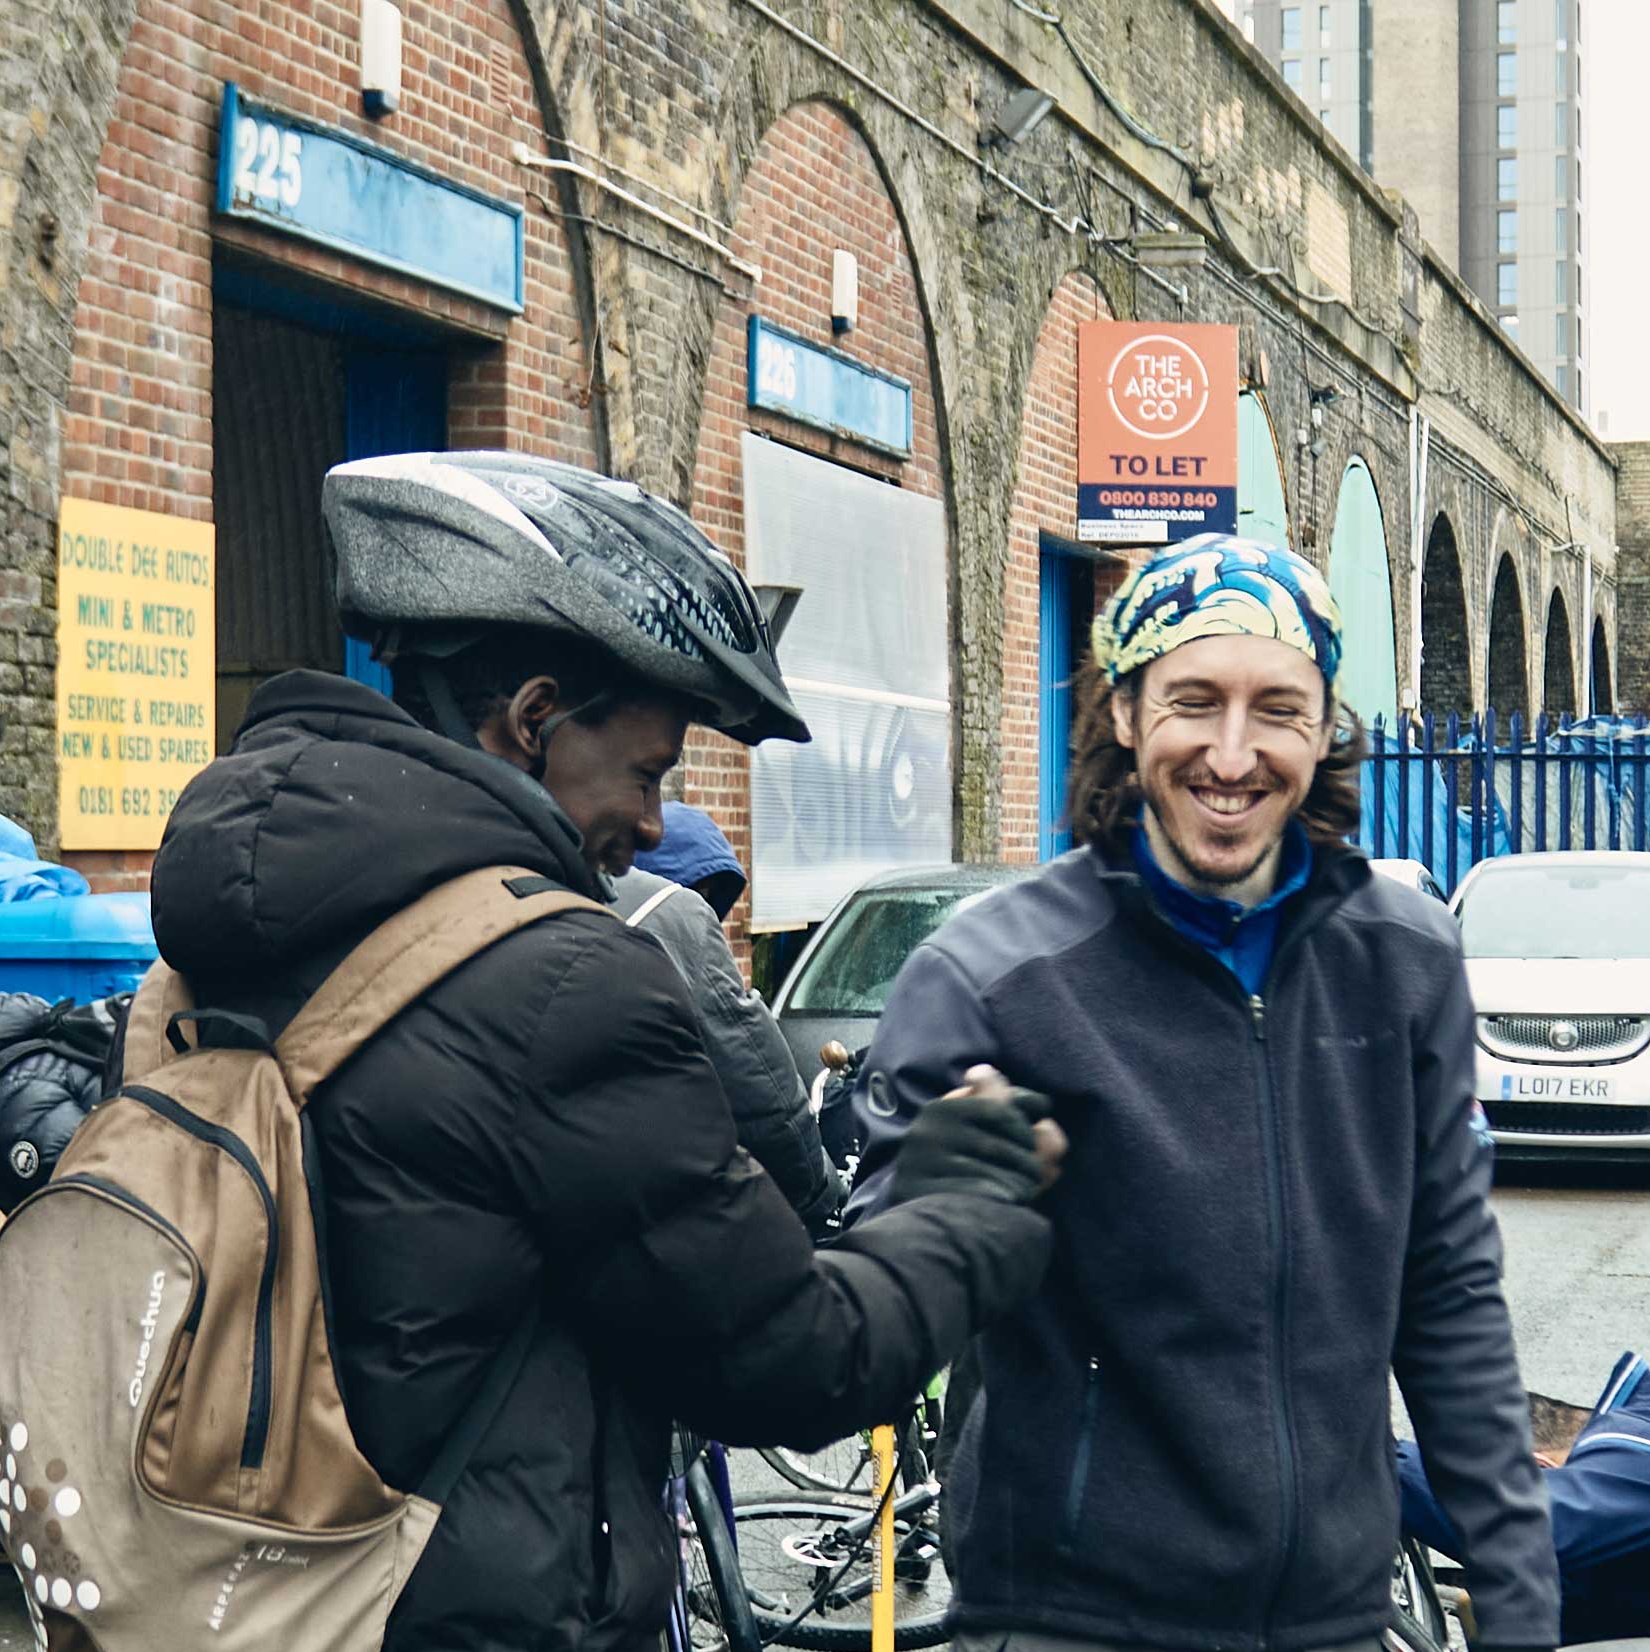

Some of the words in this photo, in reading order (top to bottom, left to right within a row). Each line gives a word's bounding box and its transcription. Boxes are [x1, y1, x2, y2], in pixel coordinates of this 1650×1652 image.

[234, 116, 302, 207] 225
[758, 337, 796, 401] 226
[1134, 354, 1182, 377] THE
[1124, 376, 1193, 399] ARCH
[1139, 399, 1178, 421] CO
[1109, 454, 1149, 476] TO
[1156, 456, 1208, 476] LET
[1099, 490, 1146, 507] 0800
[1148, 491, 1181, 508] 830
[1183, 492, 1218, 508] 840
[1111, 508, 1205, 522] THEARCHCO.COM
[62, 532, 124, 575] DOUBLE
[131, 544, 158, 579] DEE
[166, 550, 209, 587] AUTOS
[77, 594, 114, 629] MINI
[122, 599, 133, 631] &
[142, 603, 196, 639] METRO
[85, 639, 189, 679] SPECIALISTS
[68, 694, 126, 723] SERVICE
[133, 698, 143, 724] &
[149, 700, 205, 728] REPAIRS
[62, 731, 94, 758] NEW
[101, 733, 111, 760] &
[118, 735, 153, 762] USED
[159, 738, 209, 765] SPARES
[79, 785, 114, 815] 0181
[121, 787, 151, 816] 692
[158, 789, 183, 816] 39
[1518, 1077, 1563, 1096] LO17
[1569, 1078, 1609, 1097] EKR
[128, 1270, 166, 1408] Quechua
